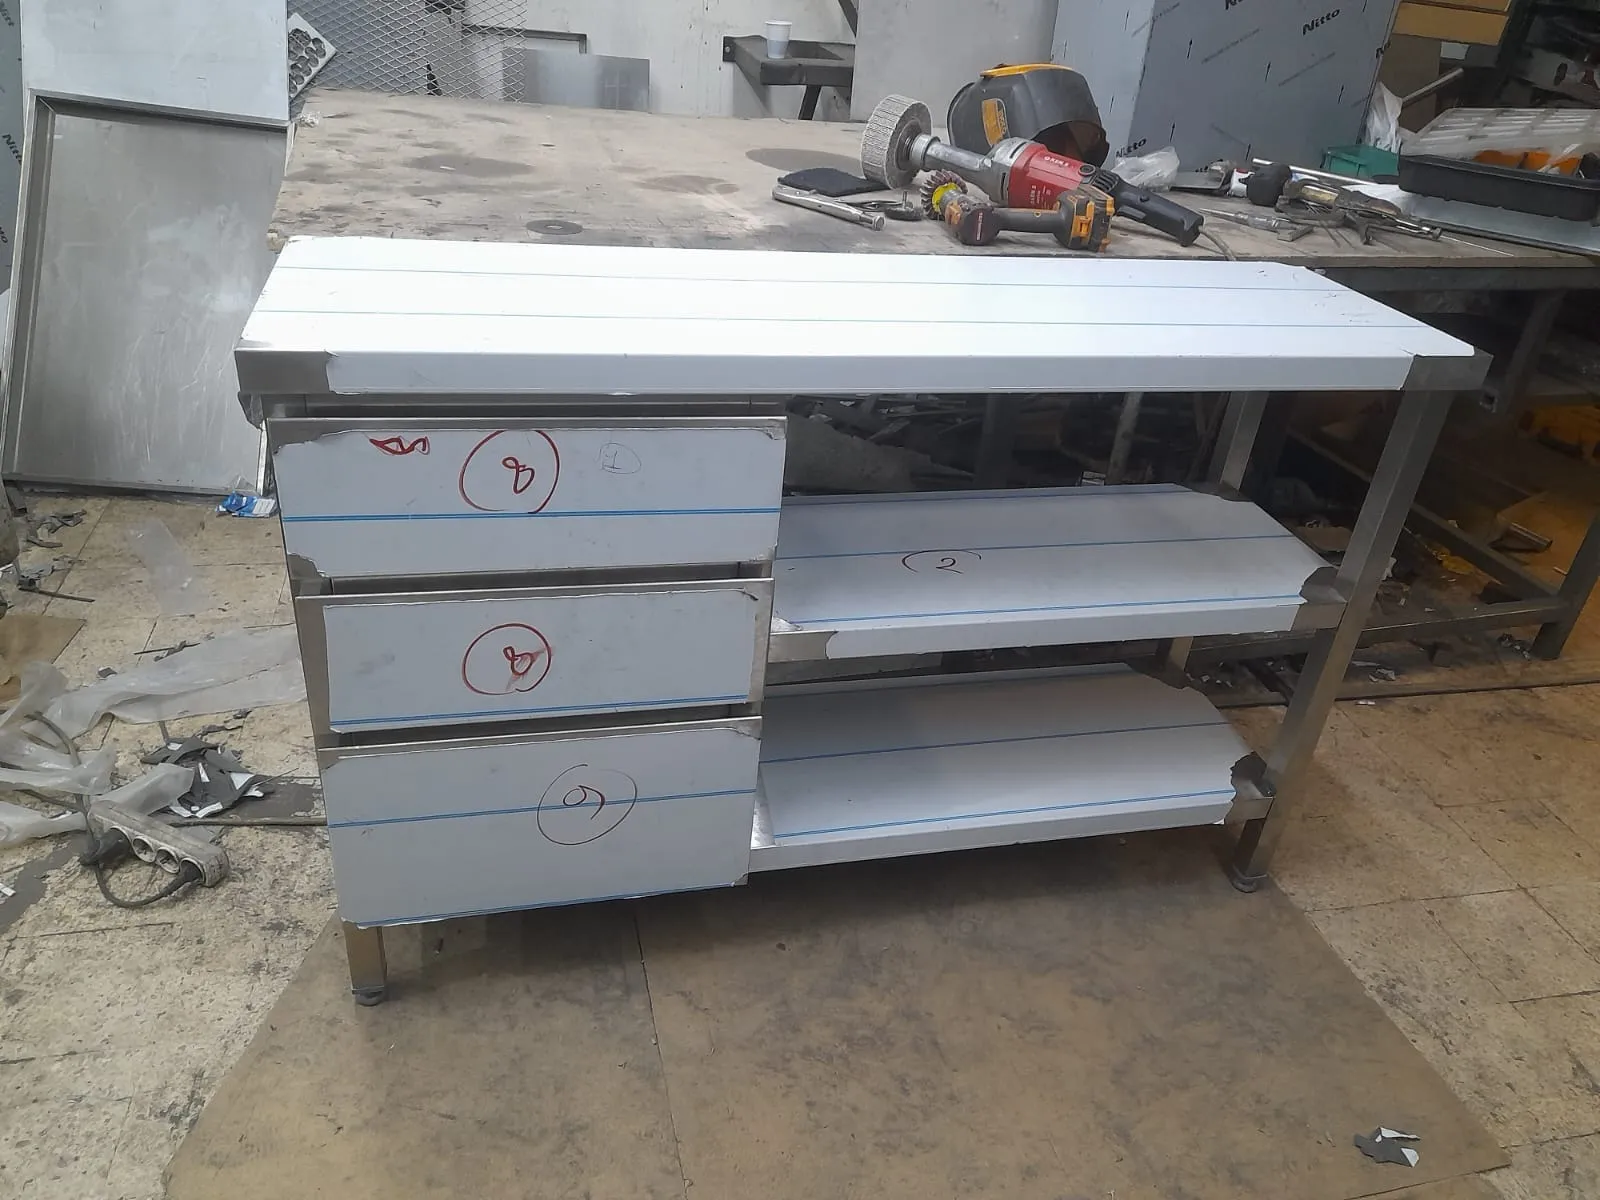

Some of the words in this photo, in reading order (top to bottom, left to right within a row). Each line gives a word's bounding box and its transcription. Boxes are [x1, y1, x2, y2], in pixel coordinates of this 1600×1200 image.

[1302, 8, 1341, 36] Nitto
[2, 133, 22, 165] Nitt
[501, 456, 536, 494] 8
[935, 556, 964, 575] 2
